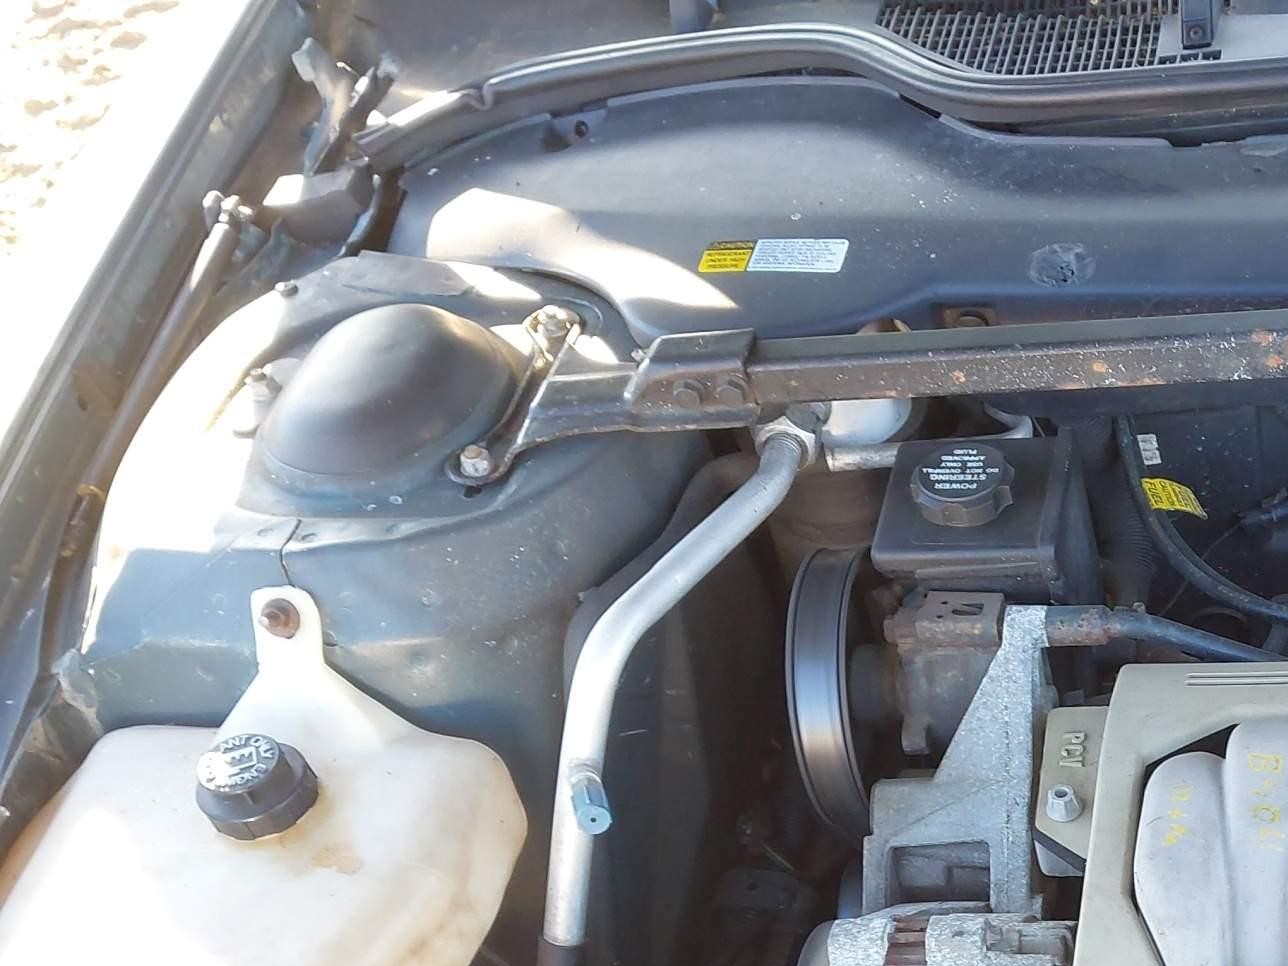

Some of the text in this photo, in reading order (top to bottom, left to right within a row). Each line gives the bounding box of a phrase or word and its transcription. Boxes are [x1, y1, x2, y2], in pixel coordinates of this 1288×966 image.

[921, 466, 961, 474] OVERFILL
[929, 473, 987, 481] STEERING
[933, 482, 977, 490] POWER
[1059, 731, 1088, 768] PCV
